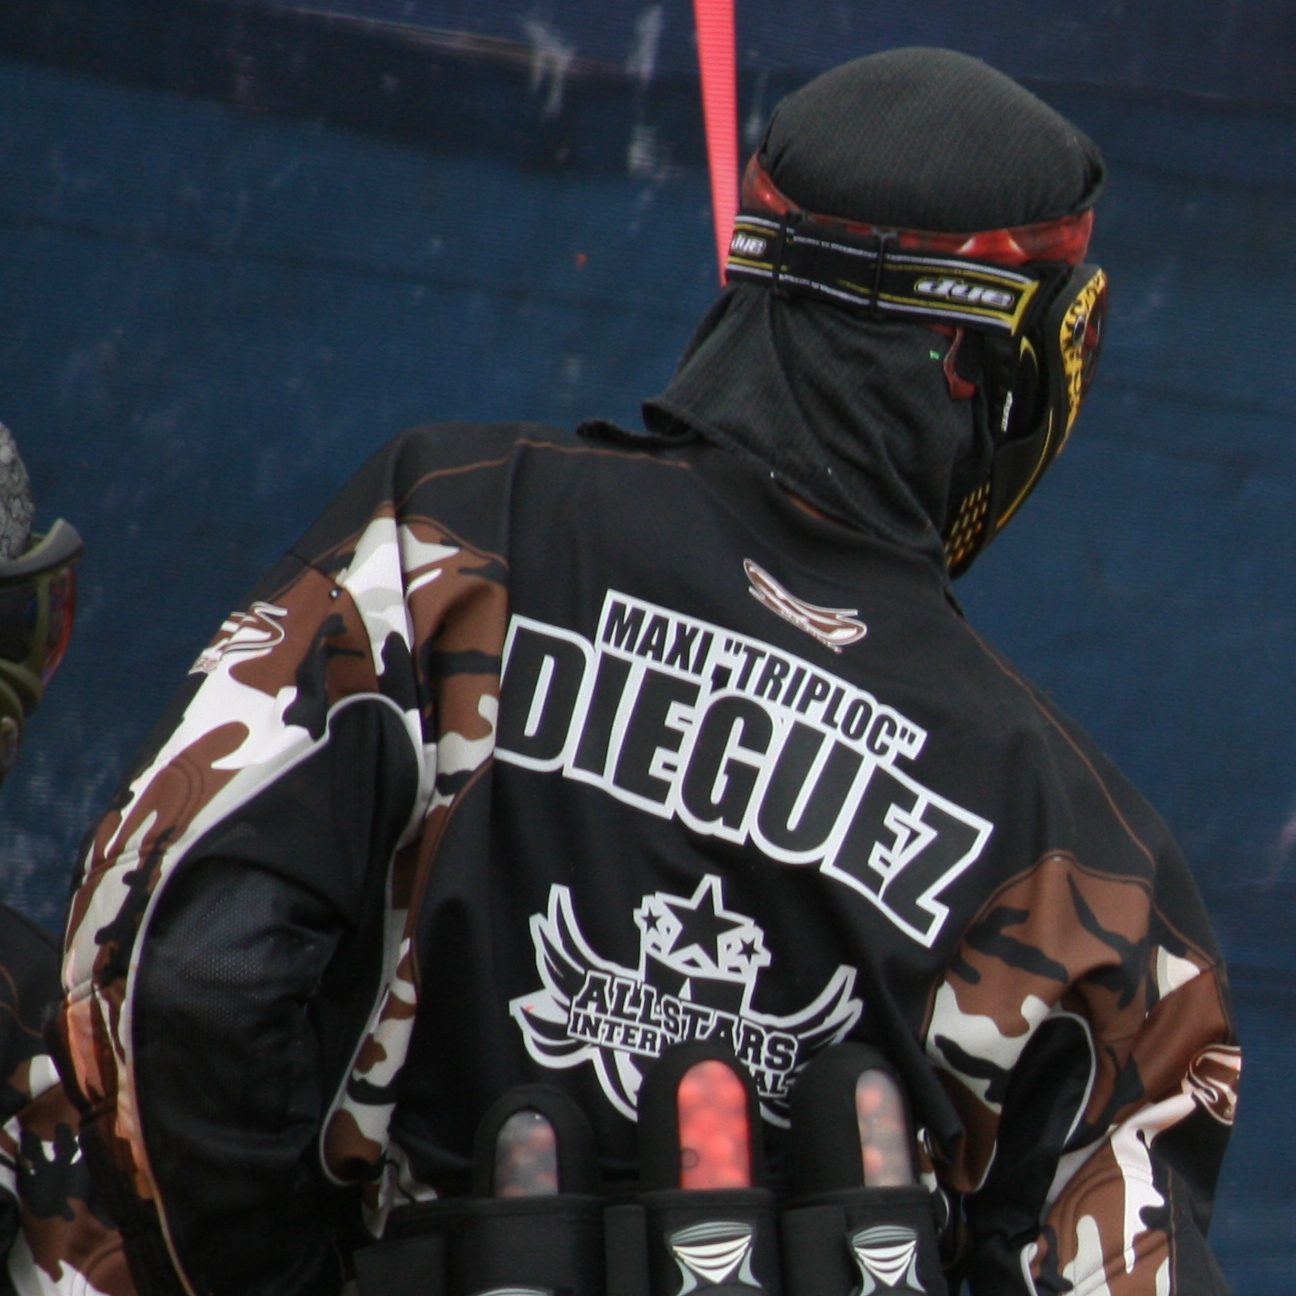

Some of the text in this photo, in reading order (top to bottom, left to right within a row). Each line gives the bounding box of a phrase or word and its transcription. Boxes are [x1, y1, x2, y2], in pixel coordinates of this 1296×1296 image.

[603, 600, 714, 676] MAXI
[724, 637, 921, 760] "TRIPLOC"
[496, 618, 992, 945] DIEGUEZ
[574, 973, 798, 1071] ALLSTARS
